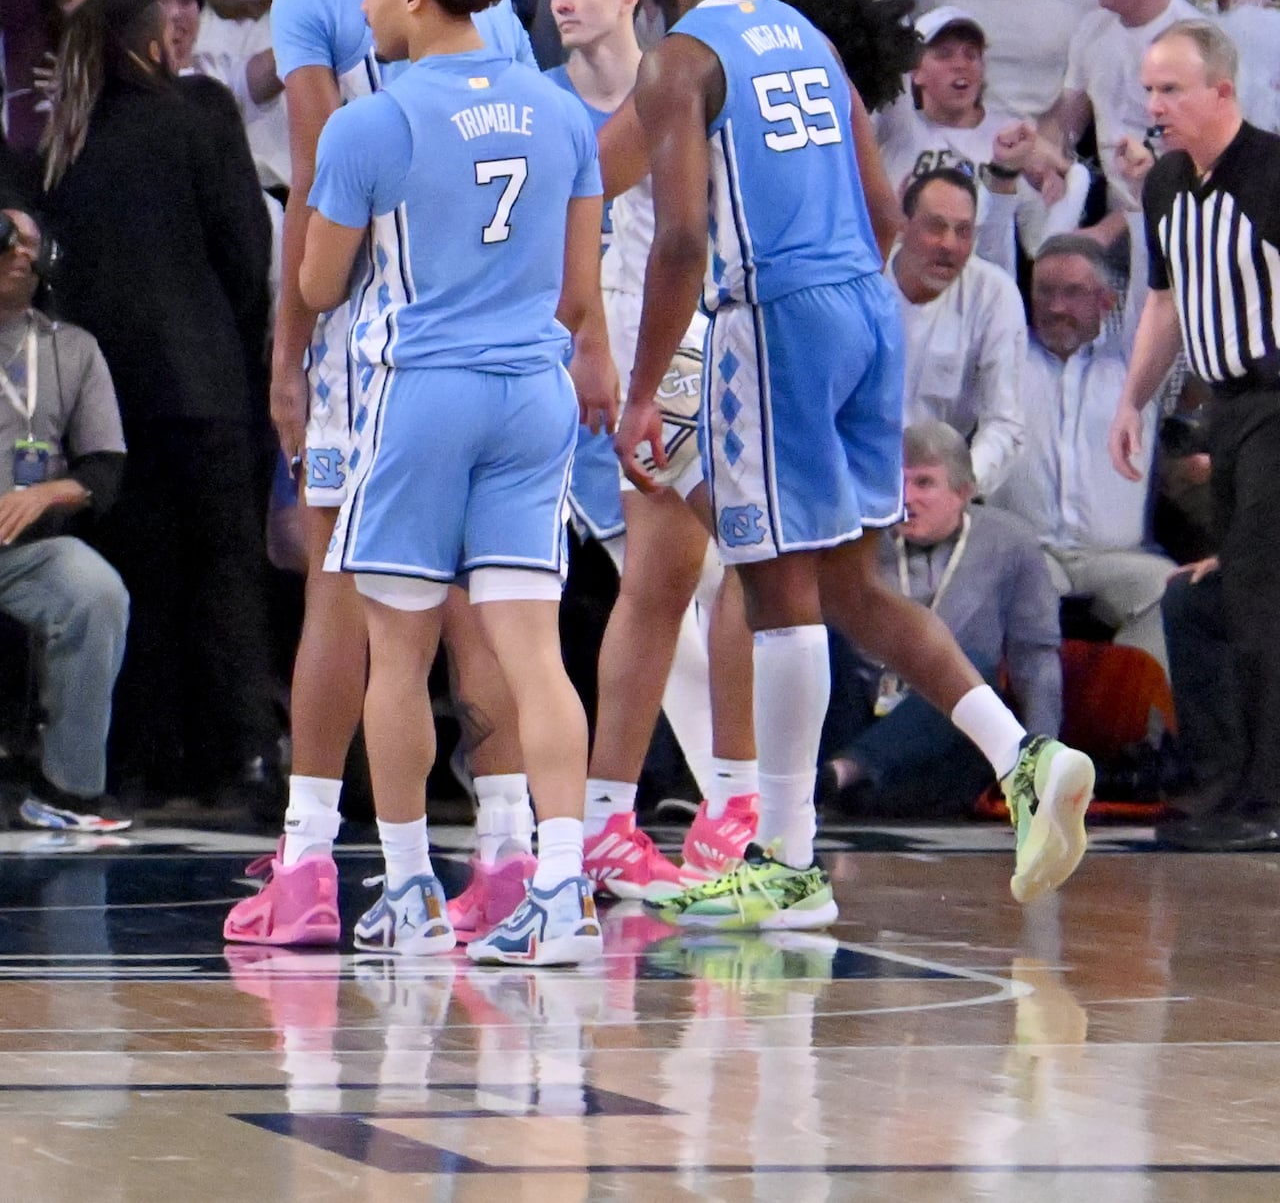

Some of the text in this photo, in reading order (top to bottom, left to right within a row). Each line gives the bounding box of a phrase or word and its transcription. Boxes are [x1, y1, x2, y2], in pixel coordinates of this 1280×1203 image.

[741, 24, 803, 56] INGRAM
[451, 103, 534, 141] TRIMBLE
[751, 66, 842, 153] 55
[474, 156, 528, 244] 7
